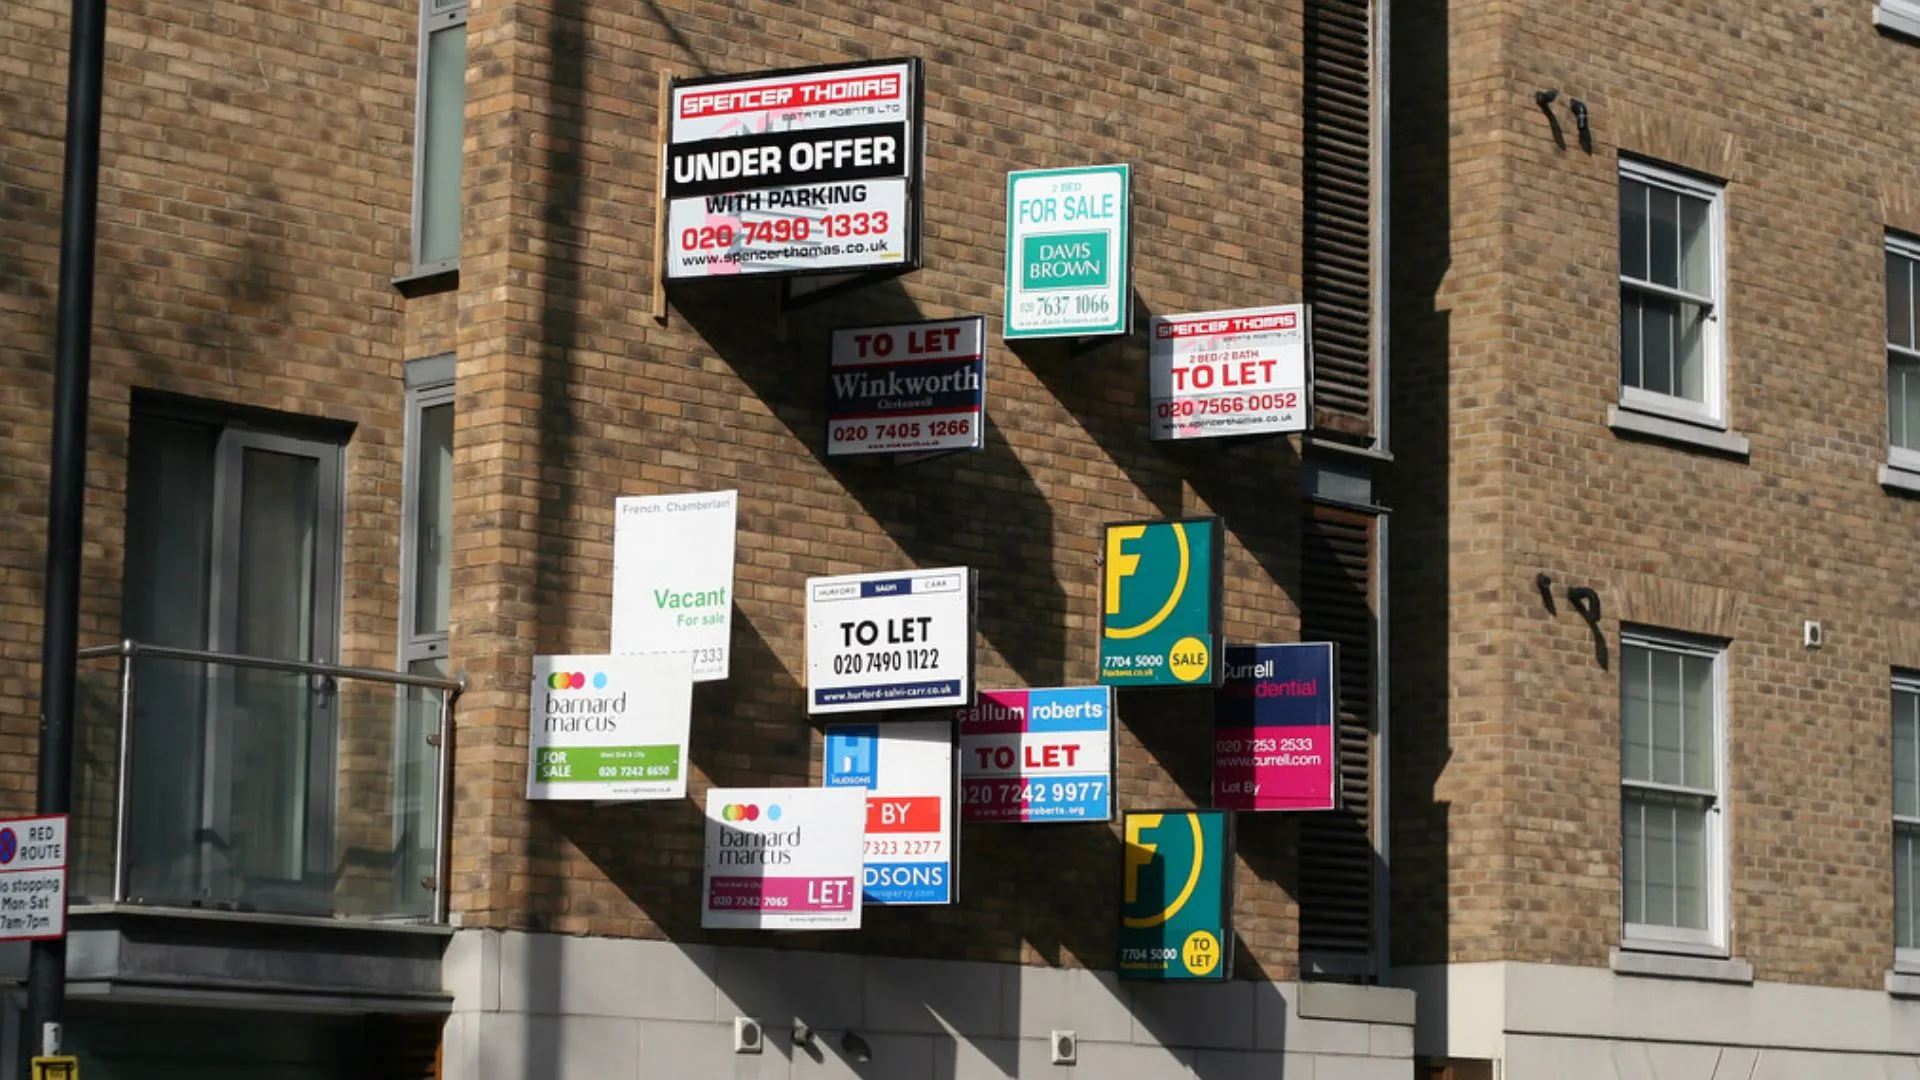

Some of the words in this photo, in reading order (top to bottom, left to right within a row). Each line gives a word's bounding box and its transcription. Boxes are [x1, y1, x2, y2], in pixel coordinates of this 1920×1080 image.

[682, 87, 793, 115] SPENCER
[800, 77, 898, 101] THOMAS
[674, 145, 781, 183] UNDER
[789, 136, 895, 172] OFFER
[706, 192, 760, 214] WITH
[768, 184, 867, 209] PARKING
[1019, 198, 1056, 224] FOR
[1064, 194, 1113, 221] SALE
[681, 224, 732, 251] 020
[742, 217, 810, 245] 7490
[820, 211, 888, 238] 1333
[682, 239, 888, 267] www.spencerthomas.co.uk
[1040, 242, 1090, 261] DAVIS
[1030, 260, 1100, 278] BROWN
[1037, 296, 1070, 316] 7637
[1076, 293, 1109, 314] 1066
[1158, 320, 1229, 337] SPENCER
[1234, 315, 1295, 330] THOMAS
[855, 333, 893, 357] TO
[908, 327, 961, 353] LET
[1190, 355, 1196, 363] 2
[1232, 350, 1259, 359] BATH
[832, 366, 979, 400] Winkworth
[1171, 365, 1214, 390] TO
[1222, 360, 1277, 386] LET
[1158, 400, 1194, 417] 020
[1198, 397, 1244, 414] 7566
[1249, 393, 1297, 410] 0052
[834, 425, 868, 441] 020
[876, 423, 920, 439] 7405
[929, 419, 969, 436] 1266
[1106, 525, 1147, 614] F
[925, 580, 947, 588] CARR
[654, 587, 726, 609] Vacant
[676, 614, 699, 627] For
[702, 612, 724, 625] sale
[840, 620, 878, 647] TO
[888, 617, 932, 643] LET
[834, 654, 862, 674] 020
[866, 651, 901, 672] 7490
[907, 649, 939, 670] 1122
[1104, 656, 1132, 668] 7704
[1135, 654, 1163, 667] 5000
[1173, 653, 1204, 665] SALE
[545, 691, 626, 714] barnard
[823, 685, 951, 701] www.hurford-salvi-carr.co.uk
[957, 703, 1024, 722] callum
[1032, 701, 1102, 720] roberts
[544, 716, 617, 732] marcus
[1216, 740, 1241, 752] 020
[1246, 739, 1276, 752] 7253
[1281, 738, 1312, 751] 2533
[544, 751, 566, 763] FOR
[976, 747, 1015, 769] TO
[1025, 744, 1080, 768] LET
[1216, 753, 1321, 767] www.currell.com
[543, 765, 571, 777] SALE
[599, 767, 616, 777] 020
[621, 767, 643, 776] 7242
[1000, 783, 1046, 803] 7242
[1052, 782, 1102, 802] 9977
[1222, 781, 1240, 793] Let
[1244, 781, 1260, 795] By
[881, 802, 912, 825] BY
[29, 827, 54, 841] RED
[720, 825, 800, 847] barnard
[20, 844, 60, 860] ROUTE
[719, 848, 791, 865] marcus
[863, 841, 897, 855] 7323
[904, 840, 941, 854] 2277
[1124, 814, 1164, 903] F
[12, 879, 59, 892] stopping
[863, 867, 943, 886] DSONS
[713, 896, 732, 906] 020
[736, 896, 760, 906] 7242
[808, 881, 848, 903] LET
[1122, 949, 1147, 960] 7704
[1151, 949, 1177, 960] 5000
[1192, 939, 1210, 950] TO
[1190, 955, 1211, 966] LET
